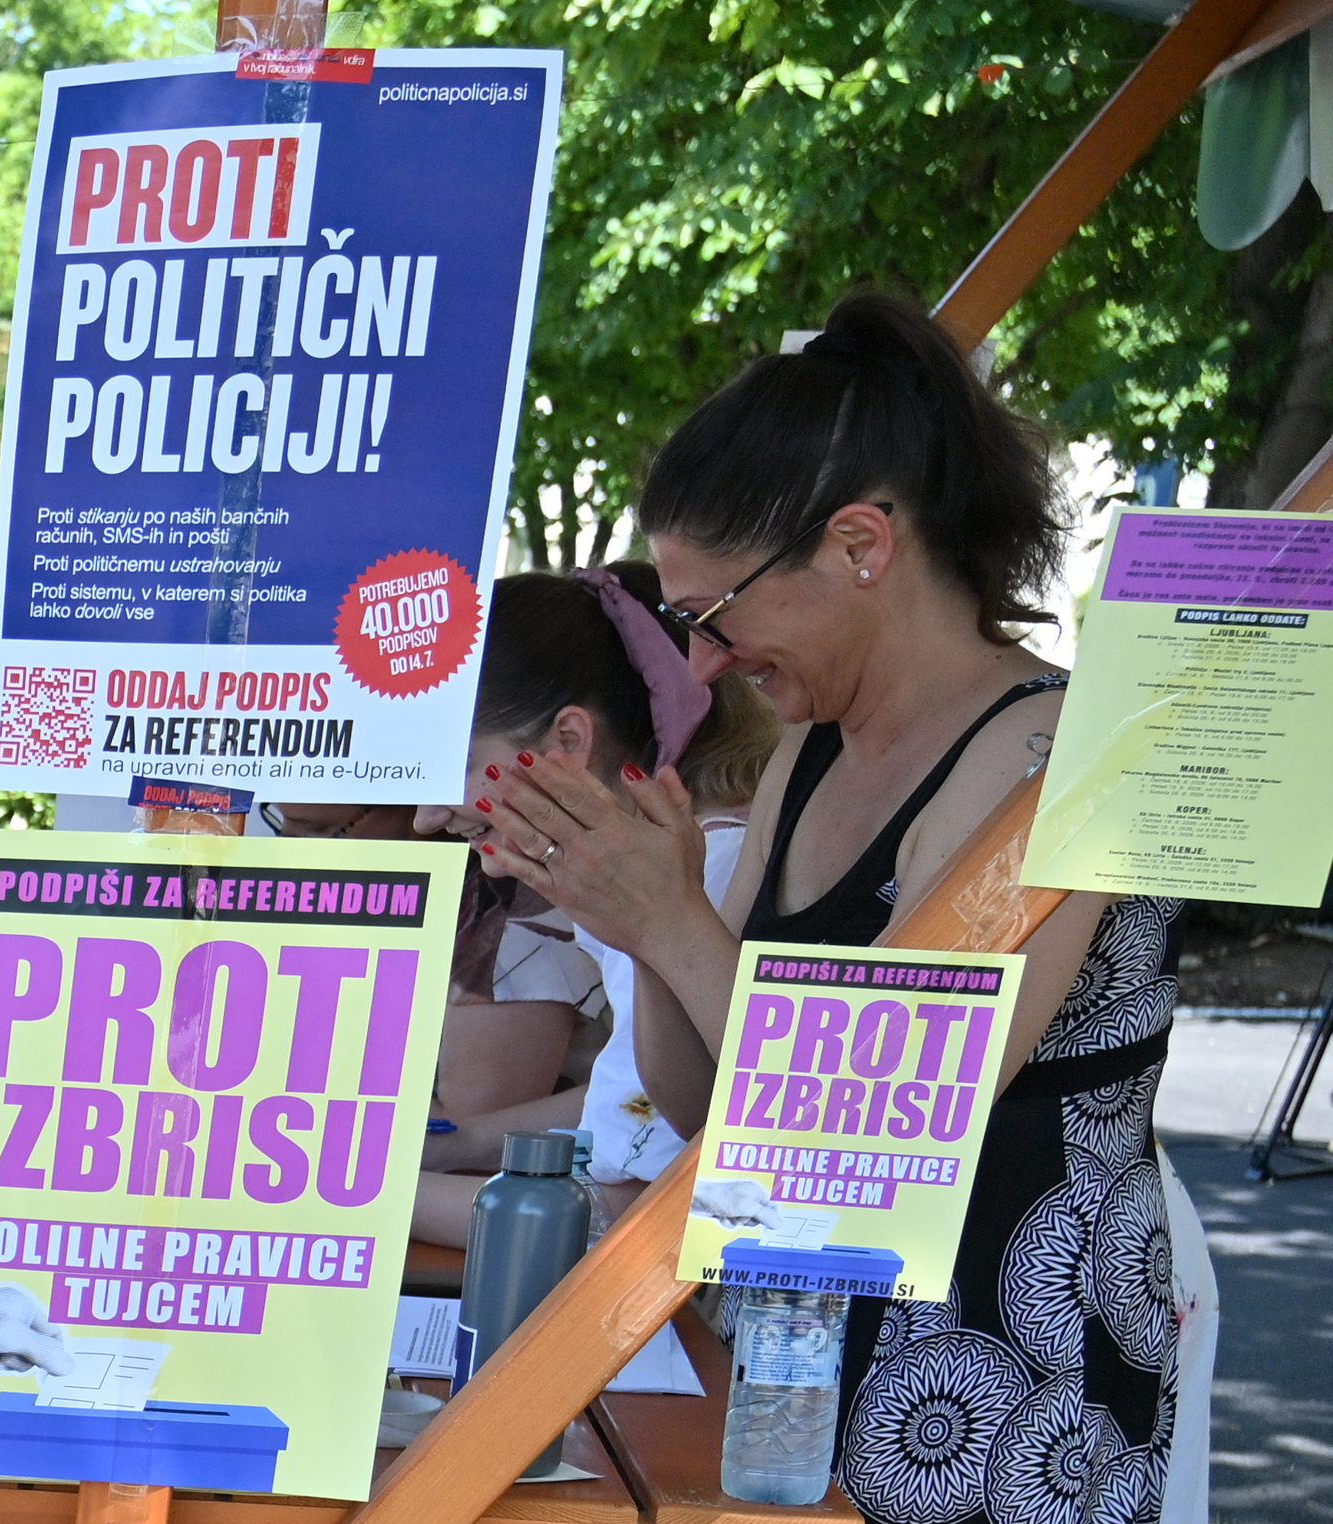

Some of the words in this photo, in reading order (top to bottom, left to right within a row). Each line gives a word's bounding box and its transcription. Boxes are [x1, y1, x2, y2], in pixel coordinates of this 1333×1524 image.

[379, 83, 528, 105] politicnapolicija.si
[69, 137, 300, 246] PROTI
[56, 228, 437, 361] POLITIČNI
[44, 372, 393, 475] POLICIJI!
[37, 507, 73, 524] Proti
[78, 508, 140, 528] stikanju
[143, 511, 165, 528] po
[170, 508, 216, 524] naših
[222, 508, 289, 525] bančnih
[36, 527, 97, 545] računih,
[102, 527, 163, 544] SMS-ih
[169, 528, 183, 544] in
[188, 528, 229, 548] pošti
[33, 555, 69, 571] Proti
[72, 555, 165, 575] političnemu
[170, 557, 281, 577] ustrahovanju
[31, 583, 66, 599] Proti
[70, 584, 136, 602] sistemu,
[141, 588, 151, 600] v
[156, 585, 225, 601] katerem
[230, 586, 244, 601] si
[248, 586, 307, 604] politika
[359, 568, 449, 604] POTREBUJEMO
[30, 602, 71, 619] lahko
[74, 603, 123, 620] dovoli
[125, 606, 154, 620] vse
[360, 589, 449, 640] 40.000
[1180, 611, 1219, 622] PODPIS
[1222, 612, 1256, 623] LAHKO
[1260, 614, 1306, 625] ODDATE:
[378, 626, 438, 656] PODPISOV
[1210, 628, 1272, 639] LJUBLJANA:
[390, 656, 408, 676] DO
[410, 653, 424, 671] 14.
[424, 650, 434, 667] 7.
[106, 669, 210, 710] ODDAJ
[215, 671, 331, 712] PODPIS
[102, 714, 136, 754] ZA
[143, 716, 354, 758] REFERENDUM
[102, 759, 124, 773] na
[130, 759, 204, 778] upravni
[211, 760, 262, 778] enoti
[269, 761, 293, 778] ali
[299, 764, 325, 778] na
[332, 761, 426, 783] e-Upravi.
[1179, 765, 1230, 775] MARIBOR:
[144, 786, 186, 804] ODDAJ
[1176, 805, 1212, 815] KOPER:
[1161, 845, 1206, 855] VELENJE:
[144, 877, 183, 908] ZA
[197, 878, 420, 917] REFERENDUM
[760, 961, 839, 981] PODPIŠI
[843, 966, 866, 982] ZA
[872, 967, 998, 990] REFERENDUM
[735, 993, 995, 1084] PROTI
[725, 1071, 976, 1143] IZBRISU
[722, 1144, 829, 1174] VOLILNE
[837, 1152, 956, 1183] PRAVICE
[781, 1176, 884, 1206] TUJCEM
[161, 1231, 366, 1281] PRAVICE
[702, 1267, 915, 1297] WWW.PROTI-IZBRISU.SI
[65, 1278, 244, 1327] TUJCEM
